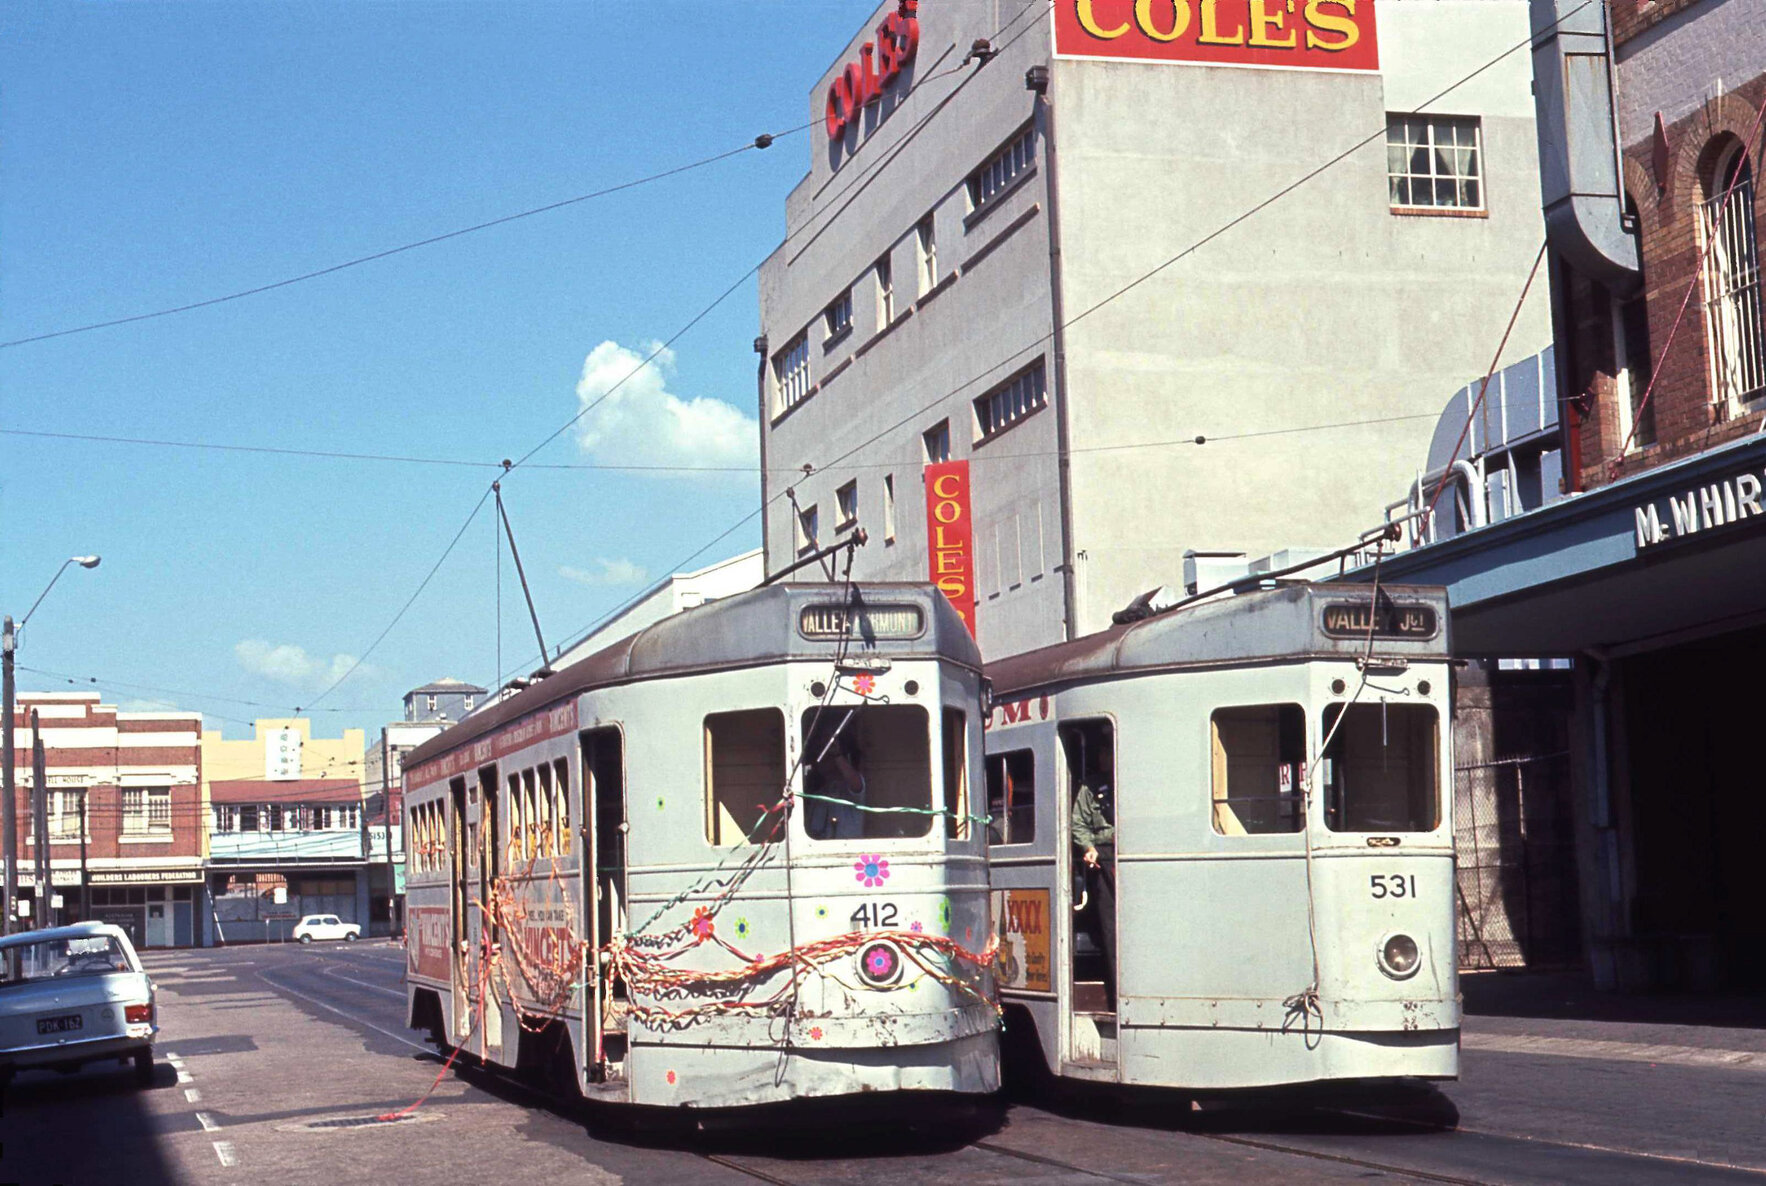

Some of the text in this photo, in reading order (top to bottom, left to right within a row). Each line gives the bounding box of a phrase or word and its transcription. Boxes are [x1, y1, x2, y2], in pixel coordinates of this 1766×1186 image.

[1077, 0, 1361, 50] COLES
[826, 0, 919, 141] COLES
[1635, 469, 1766, 547] McWHIR
[933, 474, 966, 599] COLES
[91, 872, 123, 882] BUILDERS
[1370, 874, 1417, 899] 531
[850, 902, 899, 928] 412
